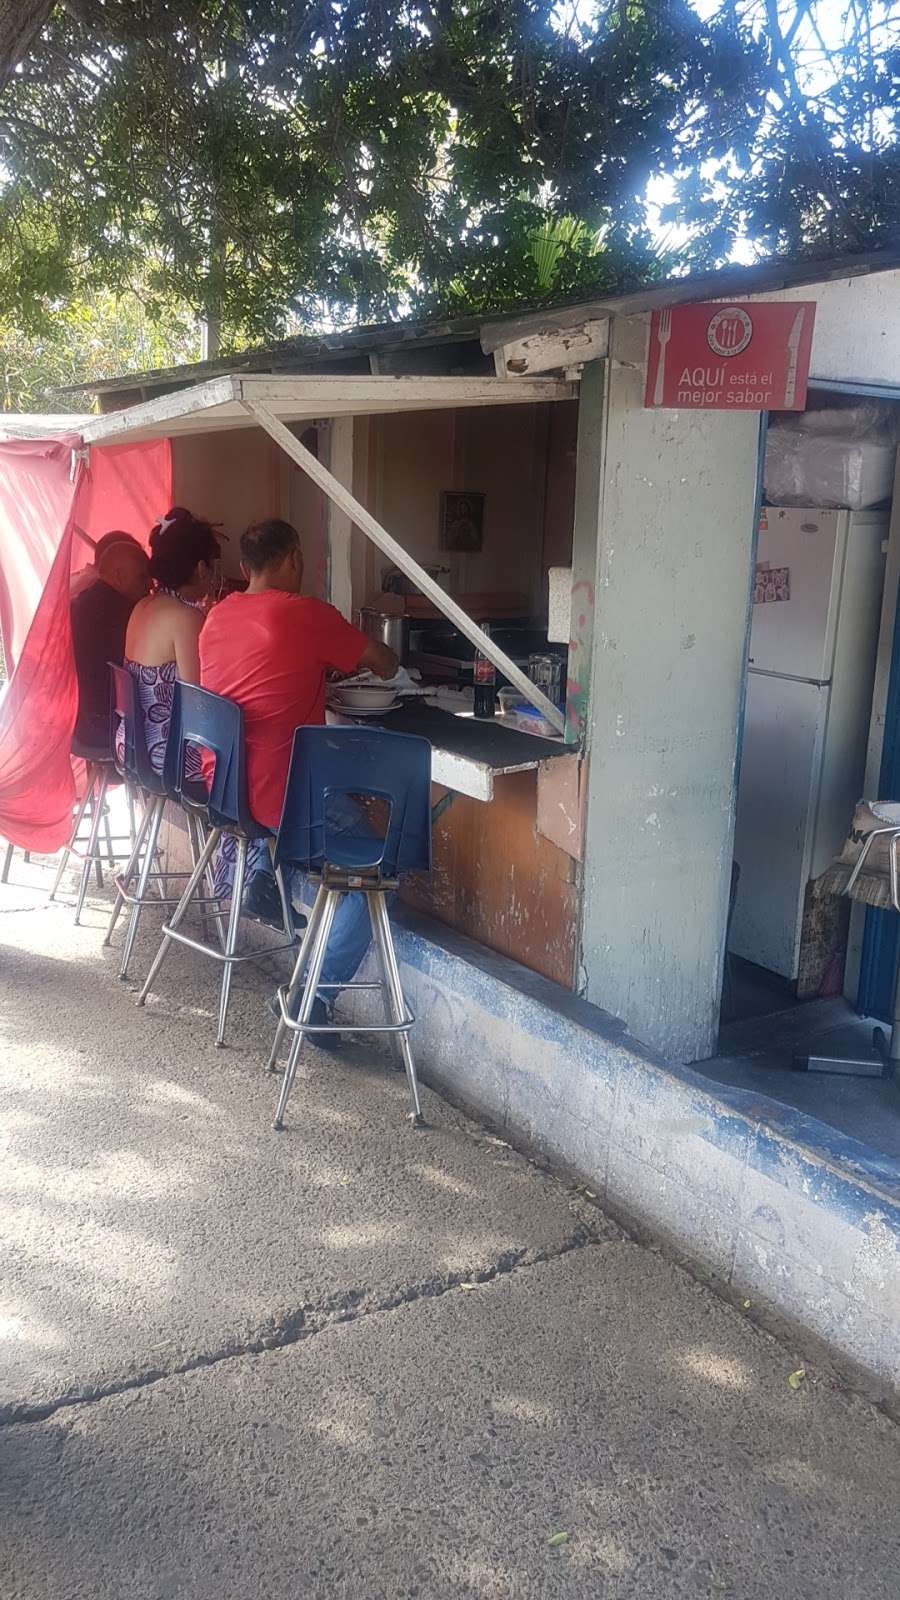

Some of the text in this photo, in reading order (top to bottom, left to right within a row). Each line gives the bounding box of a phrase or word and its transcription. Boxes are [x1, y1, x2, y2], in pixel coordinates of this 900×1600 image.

[678, 363, 773, 387] AQUÍ está el
[677, 388, 772, 407] mejor sabor
